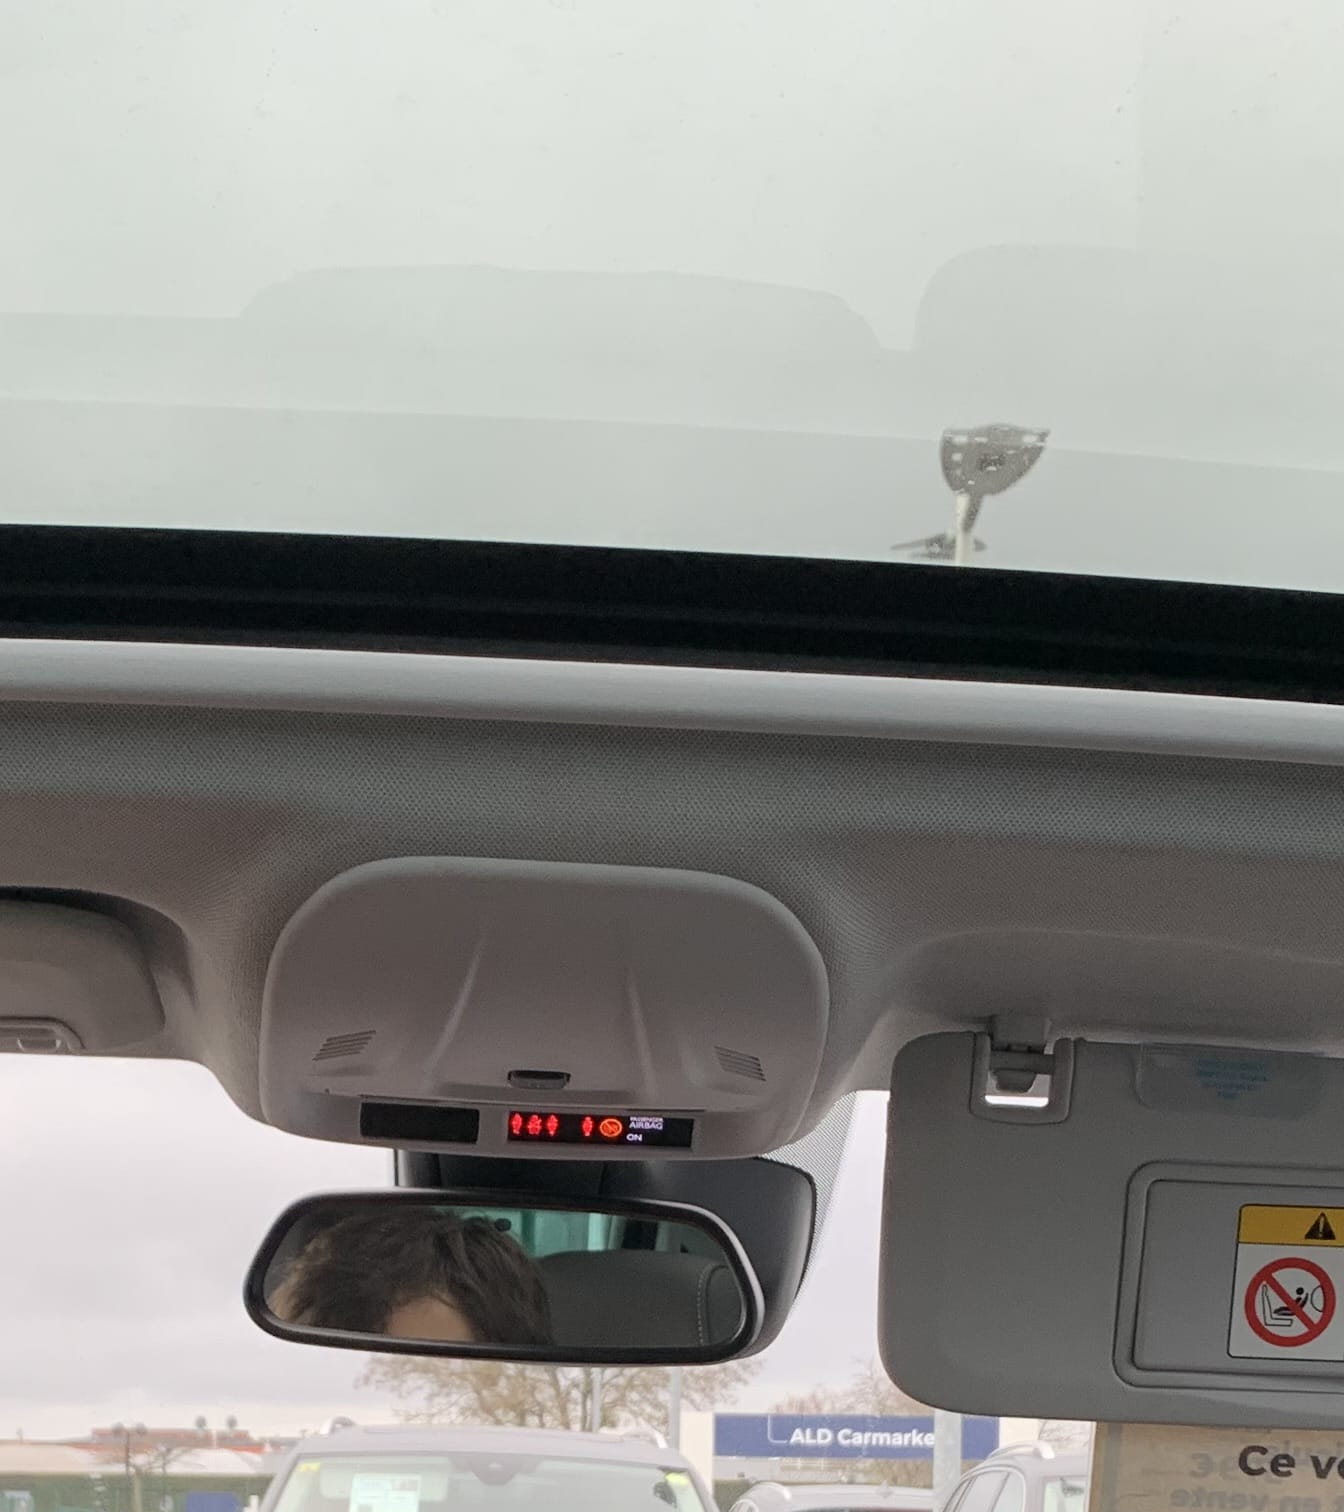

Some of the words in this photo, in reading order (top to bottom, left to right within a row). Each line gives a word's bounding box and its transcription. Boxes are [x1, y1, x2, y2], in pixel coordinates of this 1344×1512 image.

[629, 1121, 663, 1130] AIRBAG
[626, 1133, 643, 1142] ON
[788, 1427, 832, 1446] ALD
[837, 1428, 936, 1448] Carmarke
[1238, 1444, 1296, 1478] Ce
